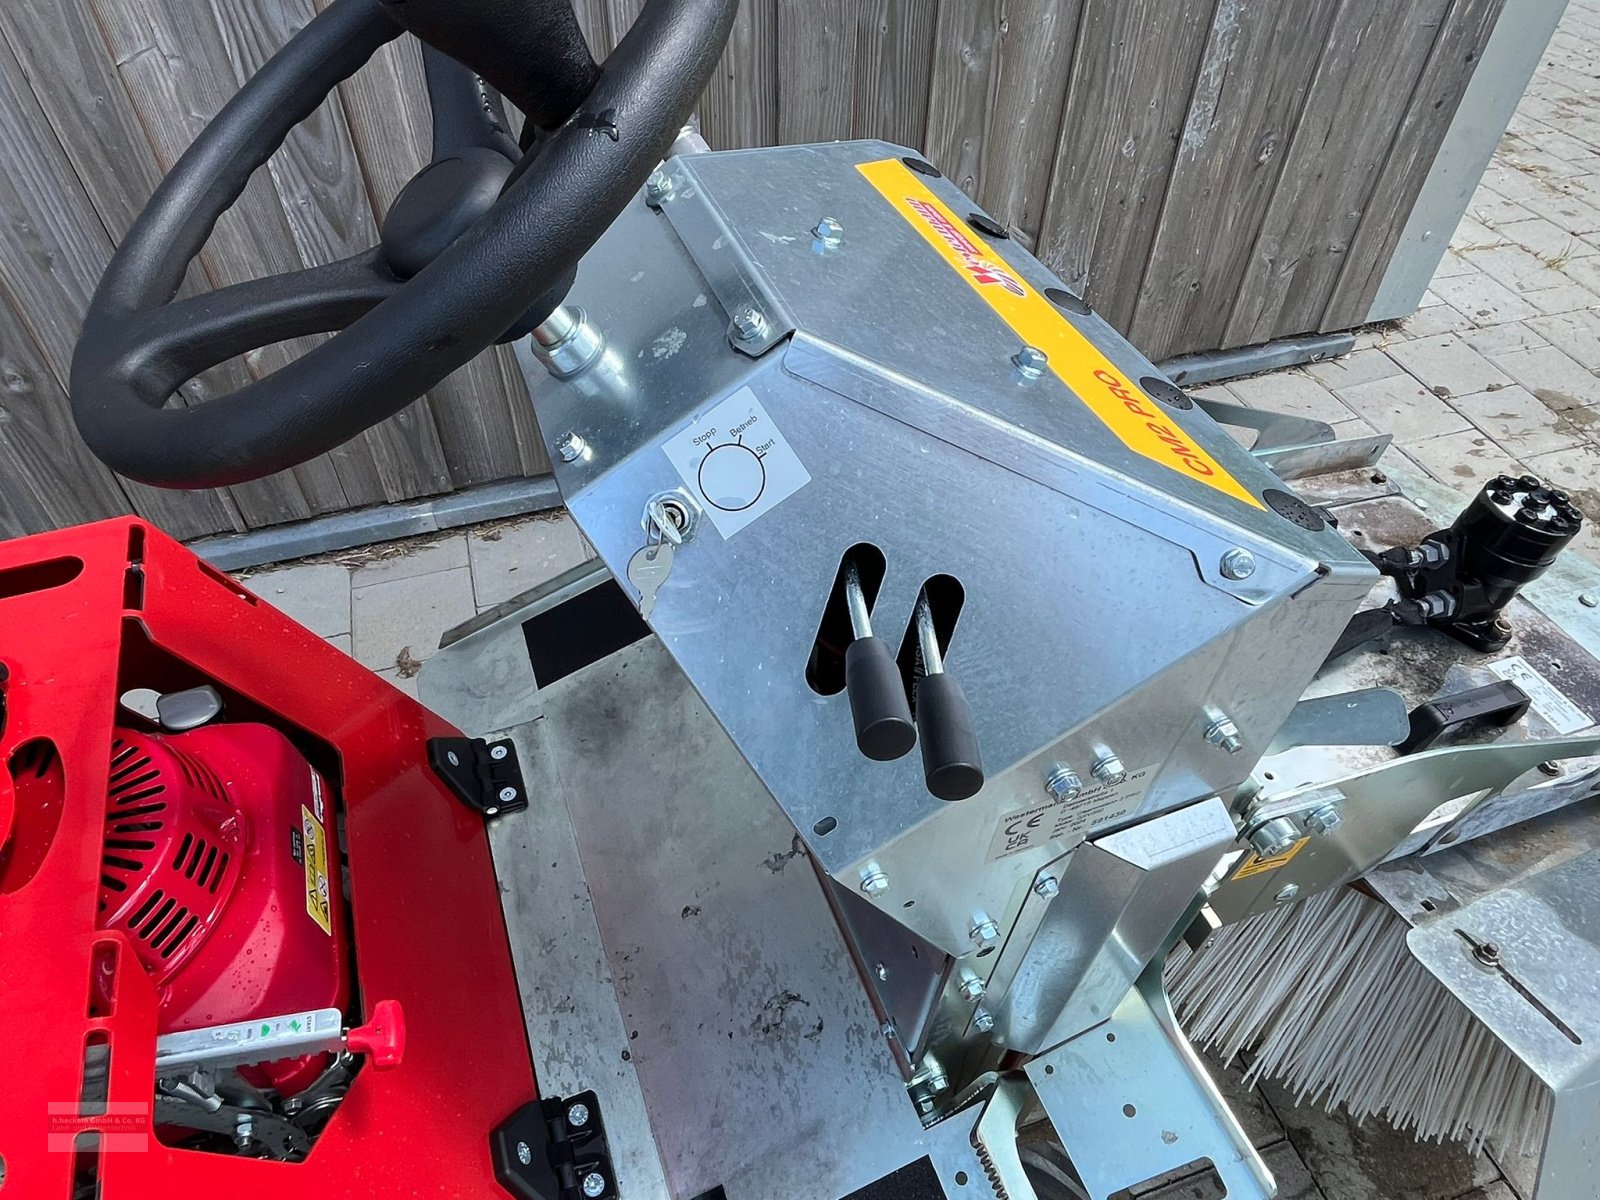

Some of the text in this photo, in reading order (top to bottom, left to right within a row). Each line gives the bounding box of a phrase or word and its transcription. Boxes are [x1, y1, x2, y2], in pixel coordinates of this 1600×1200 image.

[729, 416, 758, 438] Betrieb
[1092, 370, 1214, 476] CM2 PRO
[692, 427, 717, 446] Stopp
[755, 438, 776, 455] Start
[1131, 771, 1146, 779] KG
